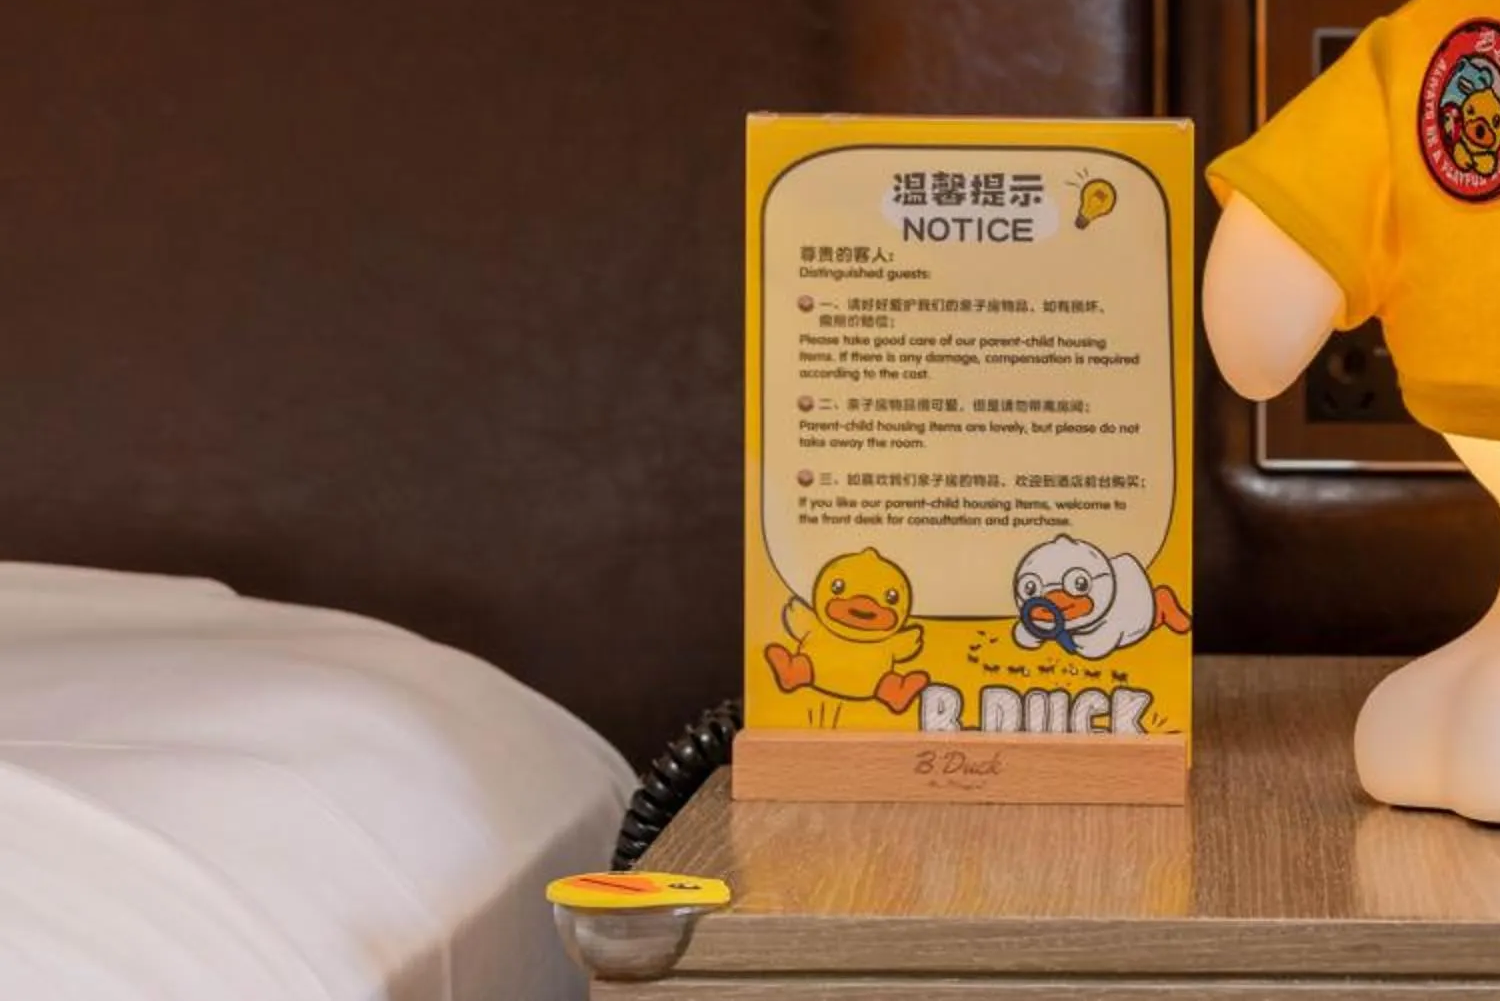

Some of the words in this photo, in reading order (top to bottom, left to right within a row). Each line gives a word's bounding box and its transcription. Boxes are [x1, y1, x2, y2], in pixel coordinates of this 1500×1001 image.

[892, 172, 1044, 208] 温馨提示
[902, 218, 1034, 243] NOTICE
[800, 266, 884, 281] Distinguished
[799, 334, 839, 346] Please
[843, 334, 871, 346] take
[873, 334, 906, 348] good
[909, 336, 937, 346] care
[939, 334, 953, 346] of
[955, 337, 976, 346] our
[979, 336, 1055, 349] parent-child
[1057, 336, 1107, 350] housing
[851, 351, 883, 363] there
[886, 352, 896, 363] is
[899, 354, 923, 366] any
[984, 353, 1072, 366] compensation
[1075, 353, 1085, 364] is
[1088, 353, 1140, 367] required
[799, 367, 861, 382] according
[863, 369, 877, 379] to
[879, 369, 899, 380] the
[799, 420, 873, 432] Parent-child
[877, 420, 926, 435] housing
[929, 421, 962, 433] items
[965, 423, 987, 432] are
[1031, 421, 1053, 433] but
[1055, 423, 1096, 436] please
[1099, 423, 1116, 434] do
[1119, 423, 1140, 435] not
[799, 437, 826, 448] take
[829, 438, 863, 450] away
[866, 437, 887, 448] the
[810, 500, 832, 510] you
[836, 497, 857, 507] like
[860, 499, 882, 508] our
[885, 498, 959, 510] parent-child
[962, 498, 1011, 511] housing
[1054, 499, 1111, 511] welcome
[1114, 500, 1127, 511] to
[799, 514, 819, 524] the
[821, 514, 851, 524] front
[854, 515, 883, 525] desk
[887, 515, 904, 525] for
[906, 514, 981, 526] consultation
[985, 516, 1009, 526] and
